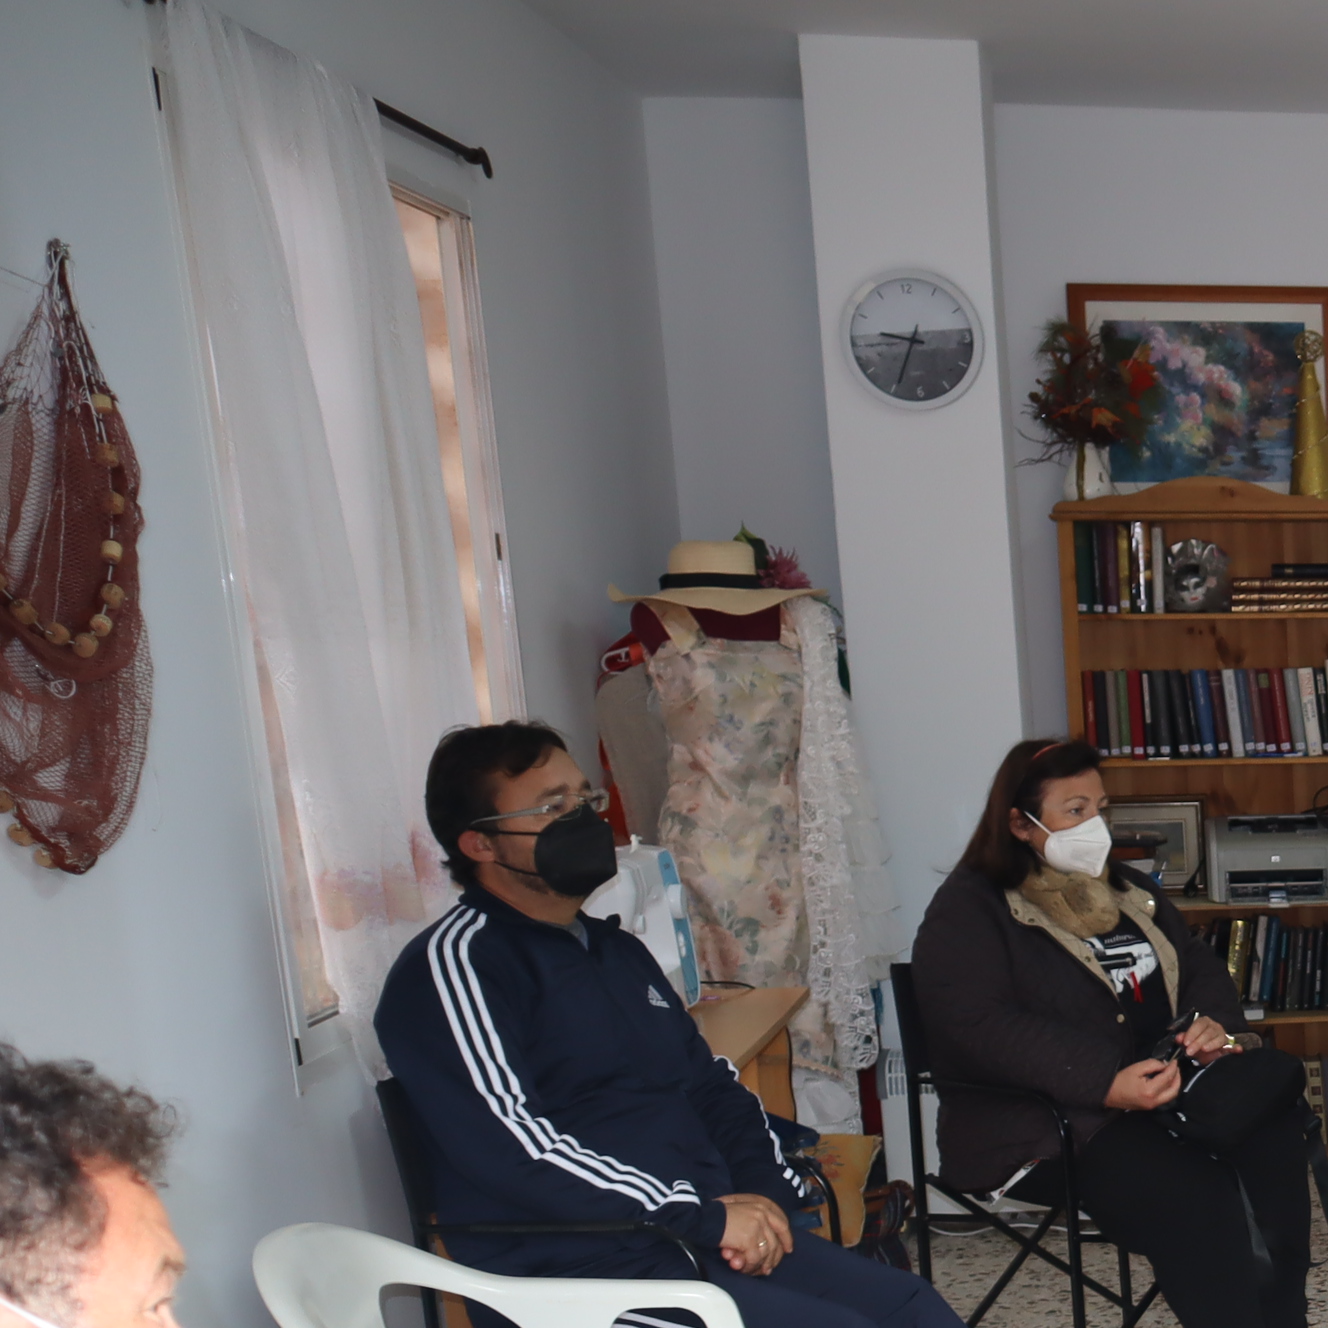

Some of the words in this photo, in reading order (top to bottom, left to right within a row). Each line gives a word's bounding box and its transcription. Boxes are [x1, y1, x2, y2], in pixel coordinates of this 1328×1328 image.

[900, 283, 912, 295] 12
[963, 332, 970, 343] 3
[916, 386, 925, 398] 6
